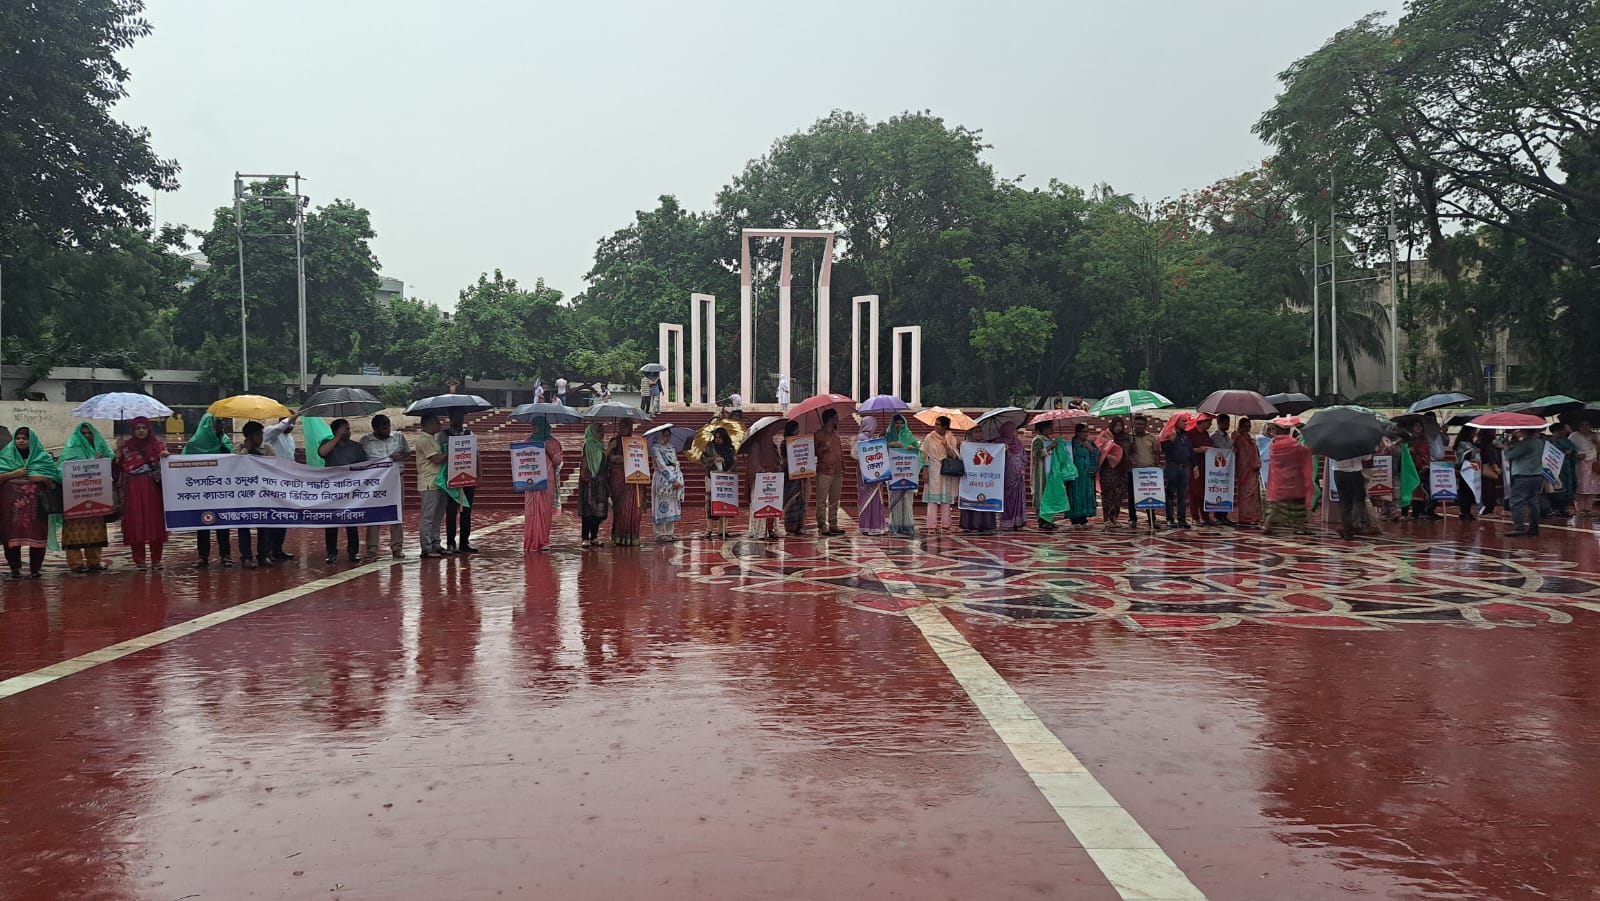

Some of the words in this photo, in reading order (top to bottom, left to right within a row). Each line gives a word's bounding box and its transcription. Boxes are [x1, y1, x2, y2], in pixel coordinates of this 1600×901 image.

[865, 451, 883, 463] কোটা
[867, 461, 884, 470] কেন?
[185, 475, 222, 487] উপসচিব
[262, 476, 277, 486] পদে
[280, 478, 303, 488] কোটা
[306, 478, 330, 489] পদ্ধতি
[333, 478, 361, 488] বাতিল
[363, 478, 380, 486] করে
[177, 492, 200, 500] সকল
[203, 490, 234, 500] ক্যাডার
[238, 489, 256, 498] থেকে
[259, 489, 286, 499] মেধার
[289, 490, 318, 501] ভিত্তিতে
[321, 491, 350, 501] নিয়োগ
[352, 489, 370, 499] দিতে
[373, 489, 387, 498] হবে
[271, 509, 298, 521] বৈষম্য
[302, 509, 332, 521] নিরসন
[335, 509, 366, 521] পরিষদ
